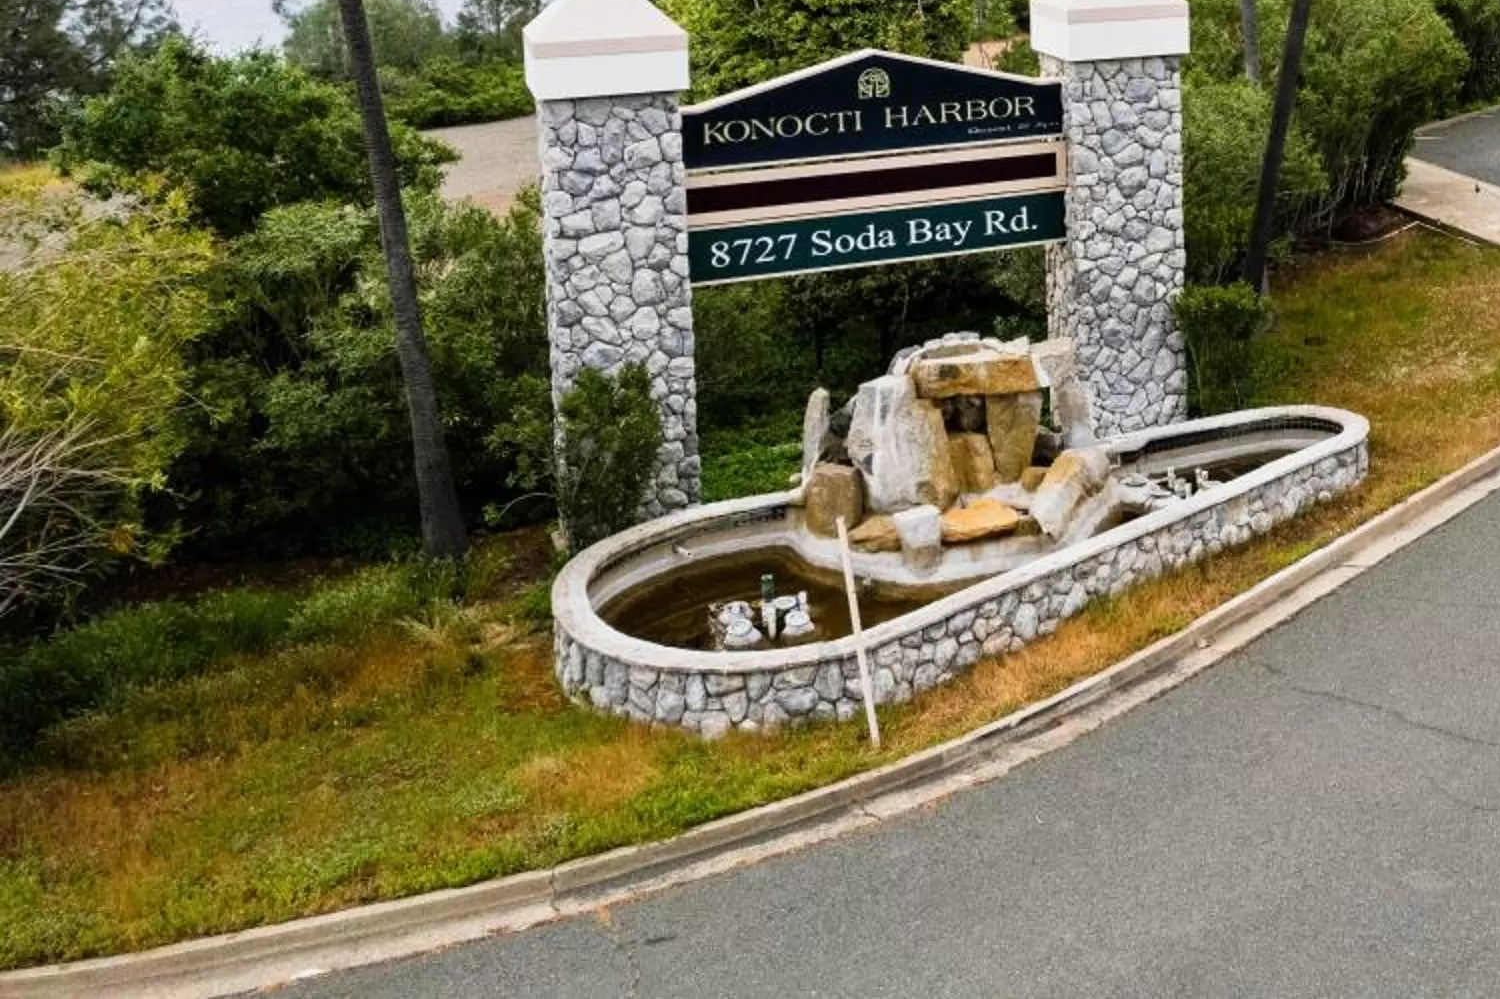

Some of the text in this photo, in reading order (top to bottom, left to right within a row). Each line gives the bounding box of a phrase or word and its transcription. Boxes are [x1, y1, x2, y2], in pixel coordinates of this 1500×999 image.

[703, 110, 864, 146] KONOCTI
[885, 96, 1036, 128] HARBOR
[710, 206, 1039, 269] 8727 Soda Bay Rd.
